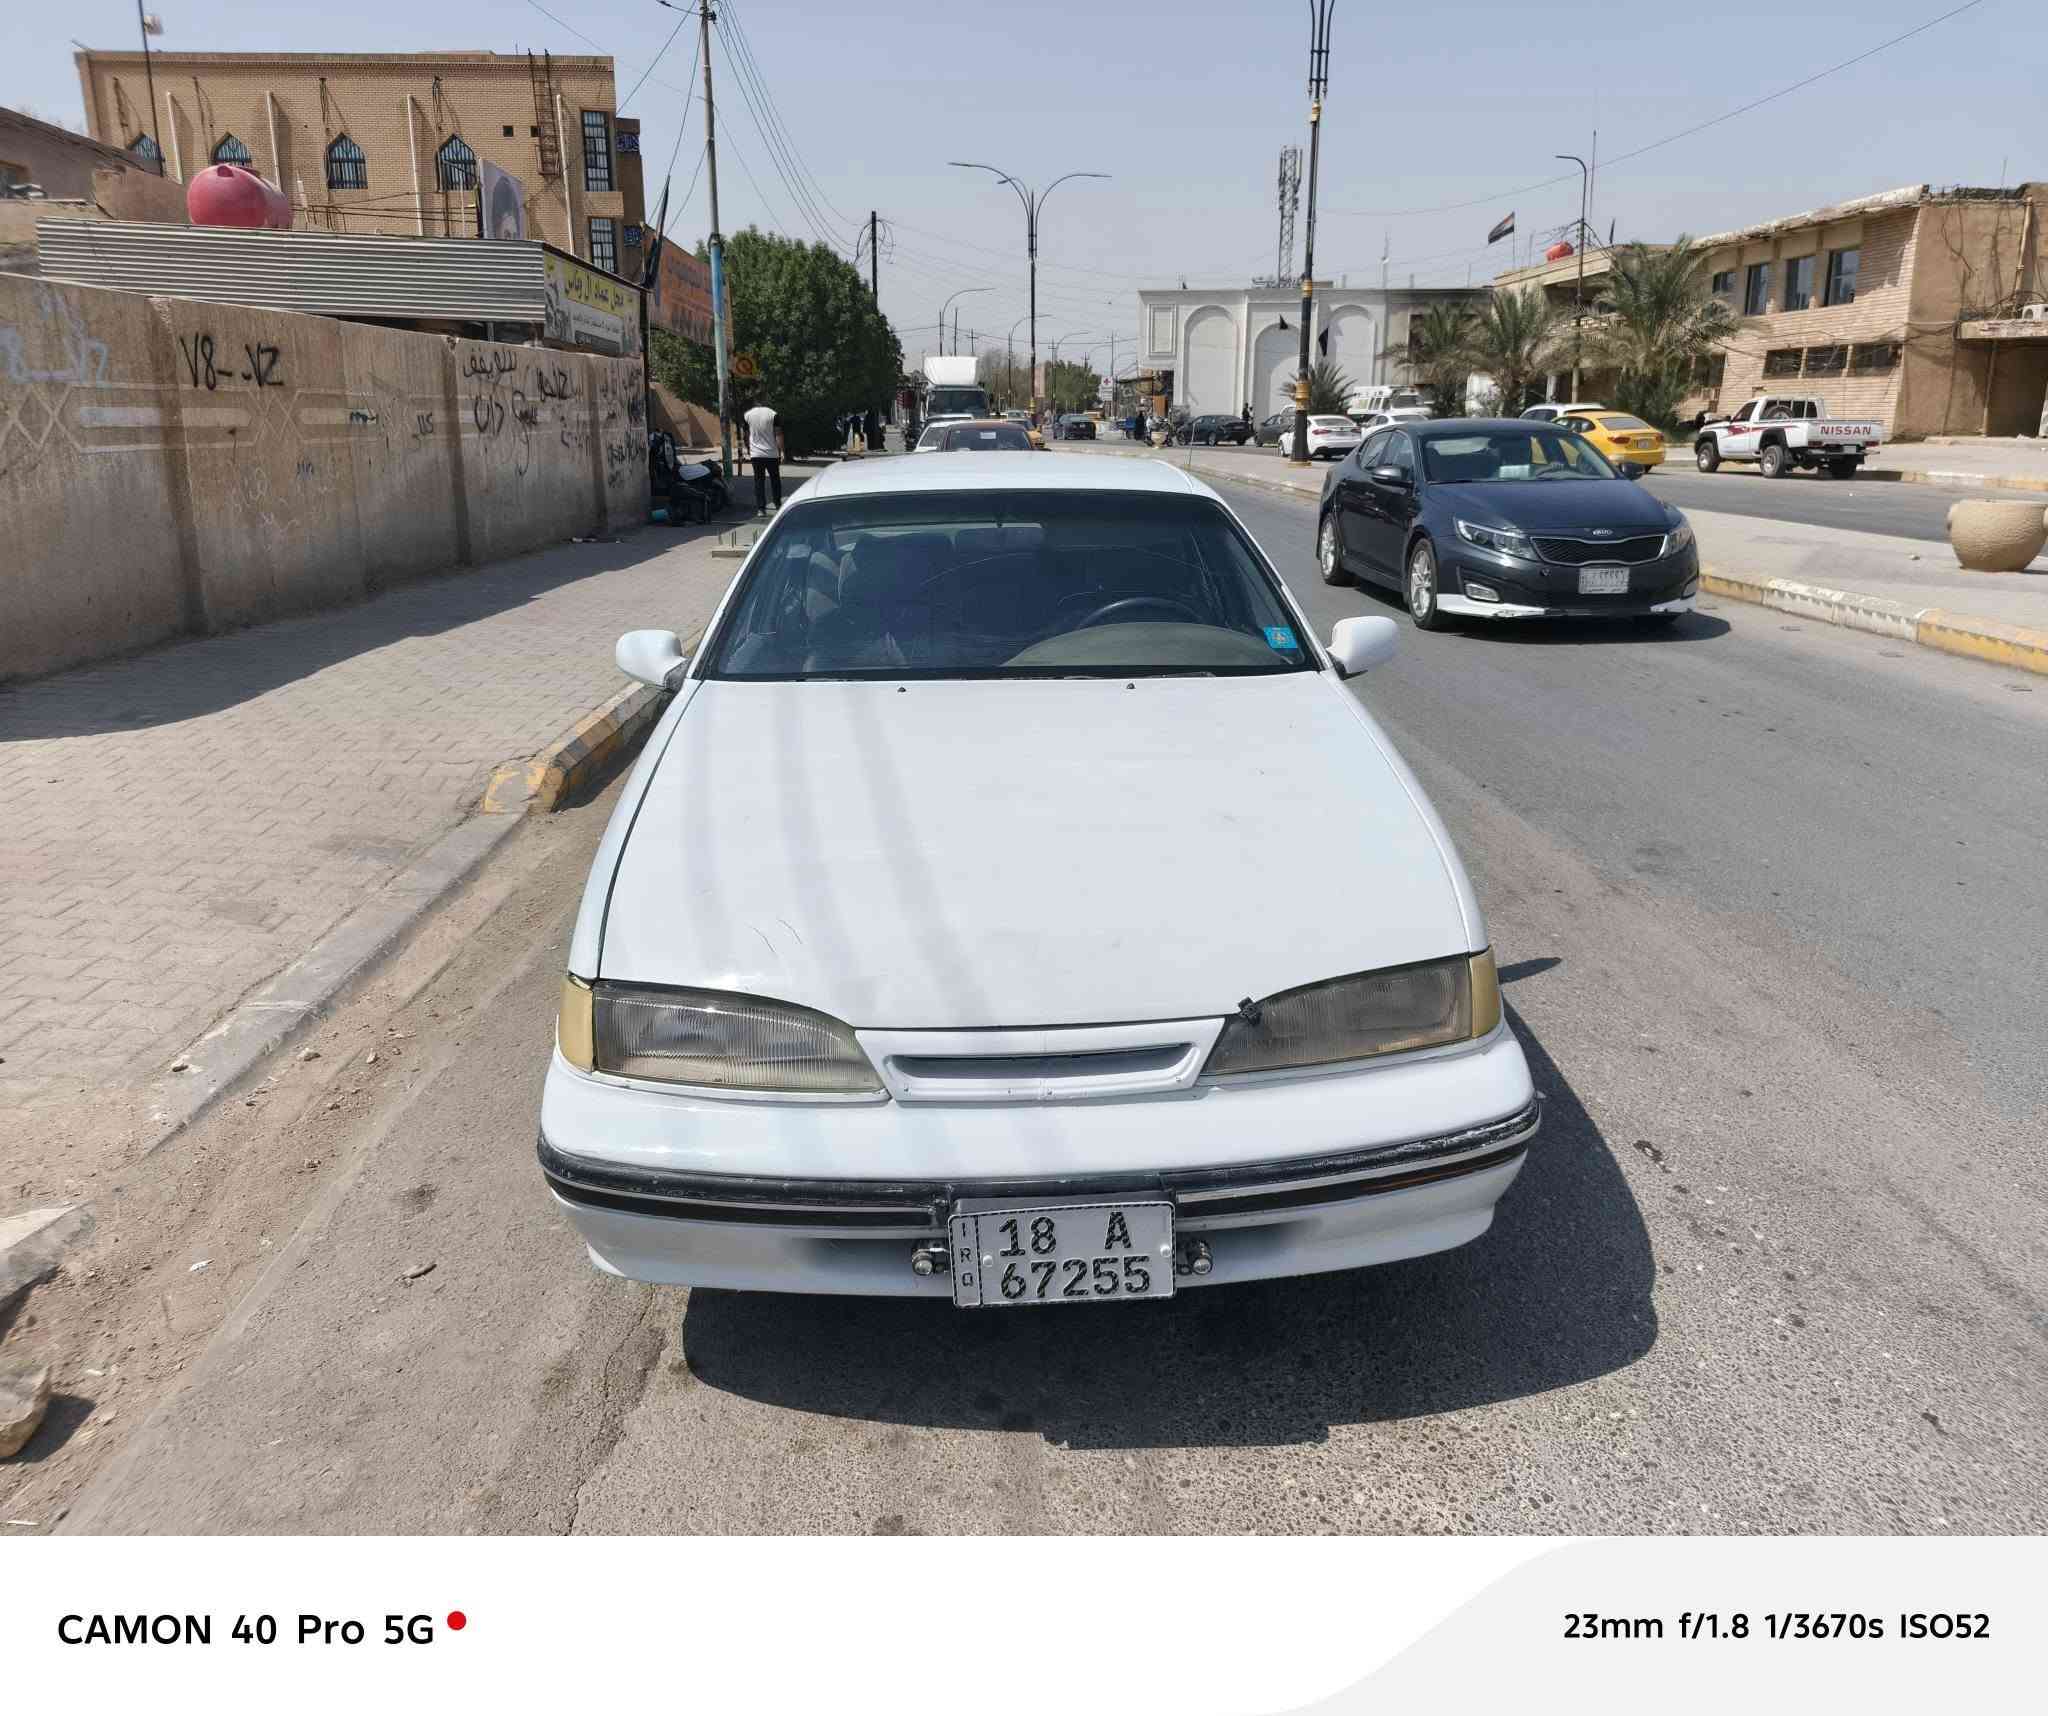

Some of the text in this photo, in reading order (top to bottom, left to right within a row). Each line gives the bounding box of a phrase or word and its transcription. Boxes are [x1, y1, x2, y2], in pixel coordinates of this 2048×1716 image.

[1820, 426, 1872, 435] NISSAN
[1000, 1211, 1132, 1257] 18 A
[1000, 1255, 1150, 1299] 67255
